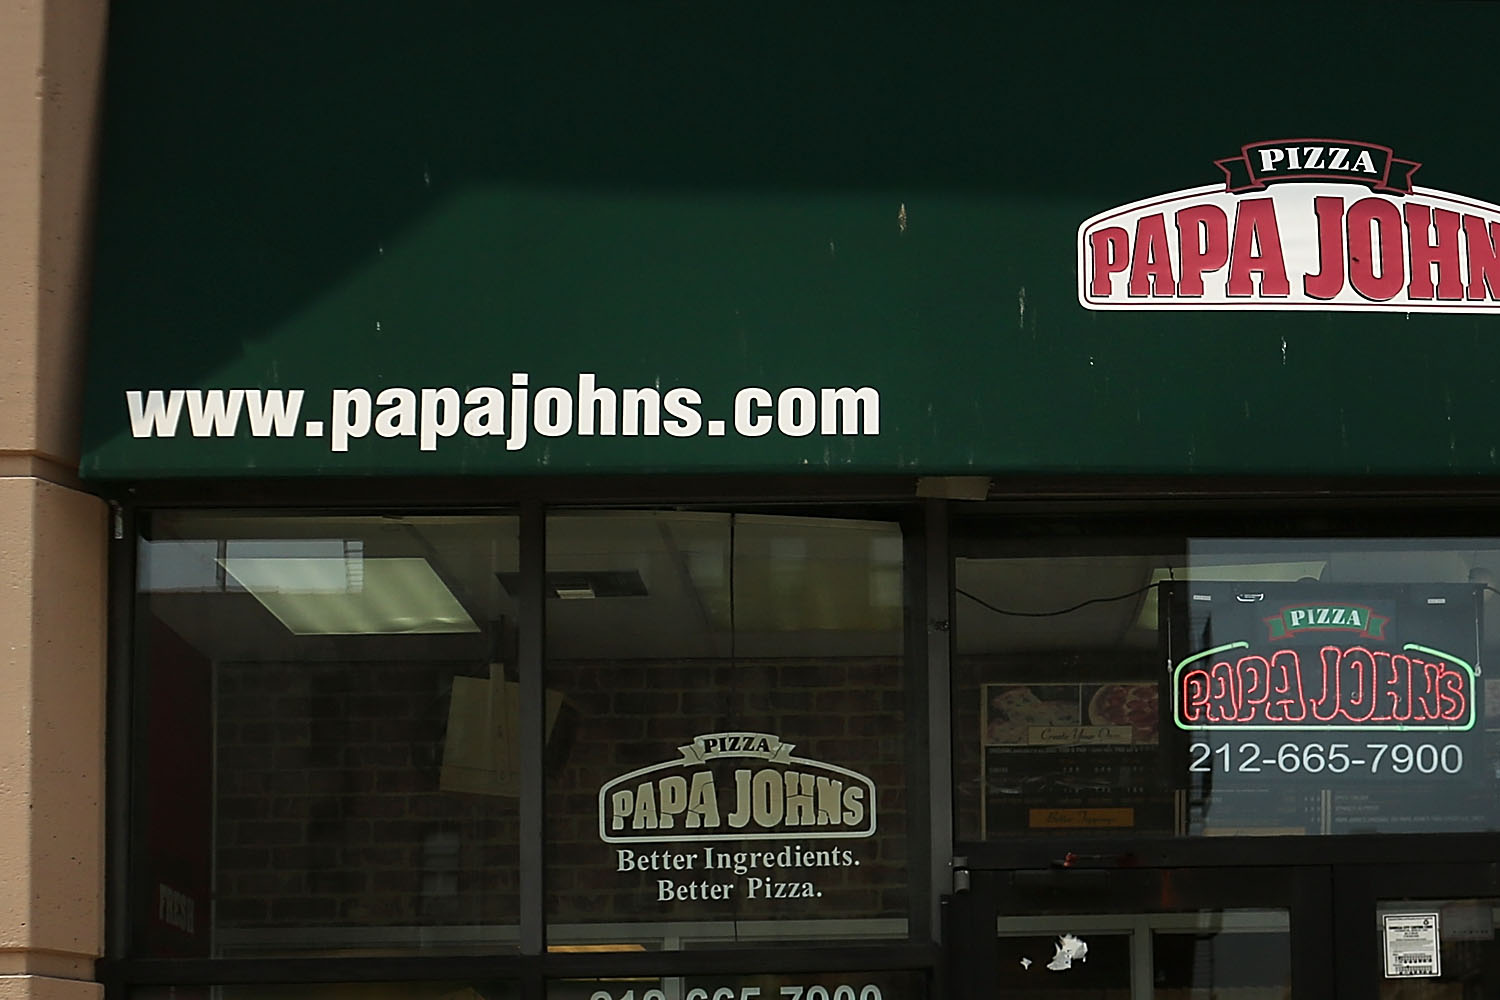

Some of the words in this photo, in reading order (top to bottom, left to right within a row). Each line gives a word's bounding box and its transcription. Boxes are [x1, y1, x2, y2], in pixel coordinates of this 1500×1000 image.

[1259, 146, 1378, 174] PIZZA
[1090, 195, 1292, 298] PAPA
[125, 372, 882, 453] www.papajohns.com
[1290, 608, 1362, 626] PIZZA
[1182, 649, 1307, 722] PAPA
[703, 736, 771, 754] PIZZA
[1187, 742, 1464, 774] 212-665-7900
[611, 769, 721, 831] PAPA
[616, 848, 698, 872] Better
[703, 844, 861, 875] Ingredients.
[656, 878, 734, 902] Better
[746, 876, 823, 900] Pizza.
